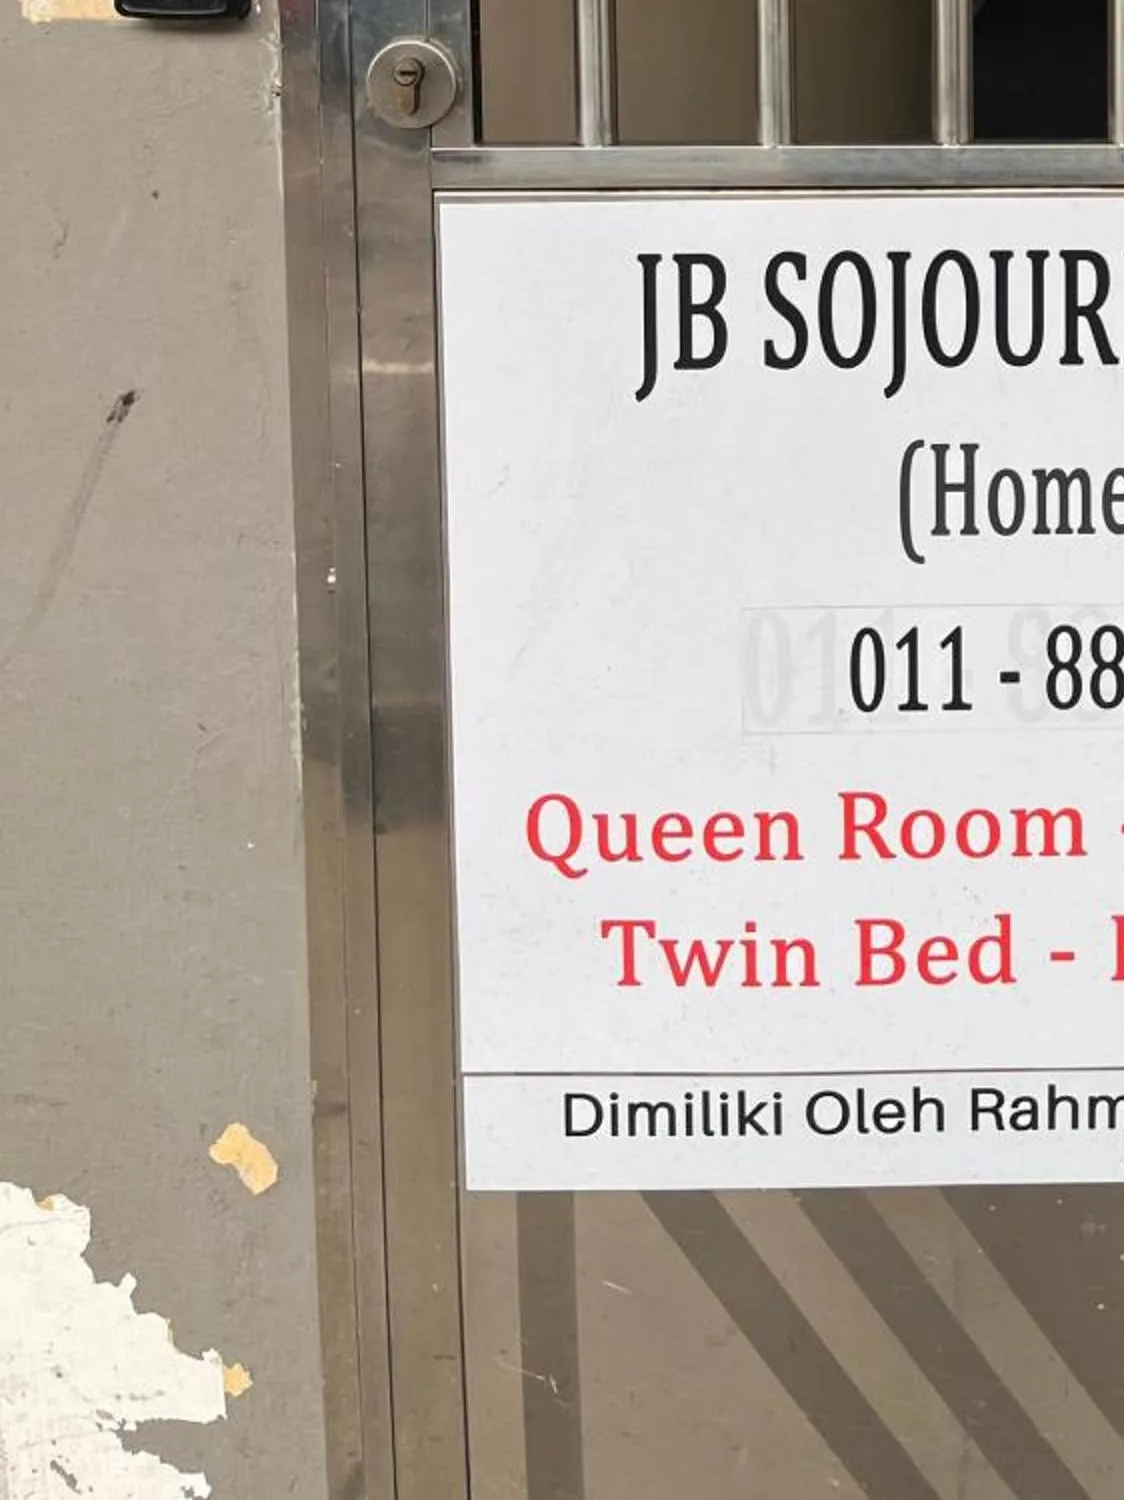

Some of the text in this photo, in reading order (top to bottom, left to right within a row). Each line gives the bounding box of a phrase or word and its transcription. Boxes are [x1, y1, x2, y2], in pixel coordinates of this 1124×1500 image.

[635, 253, 728, 404] JB
[850, 625, 973, 713] 011
[999, 671, 1021, 684] -
[526, 794, 804, 879] Queen
[838, 792, 1087, 860] Room
[601, 920, 820, 987] Twin
[855, 914, 1016, 986] Bed
[1050, 952, 1075, 961] -
[564, 1090, 783, 1137] Dimiliki
[806, 1086, 945, 1135] Oleh
